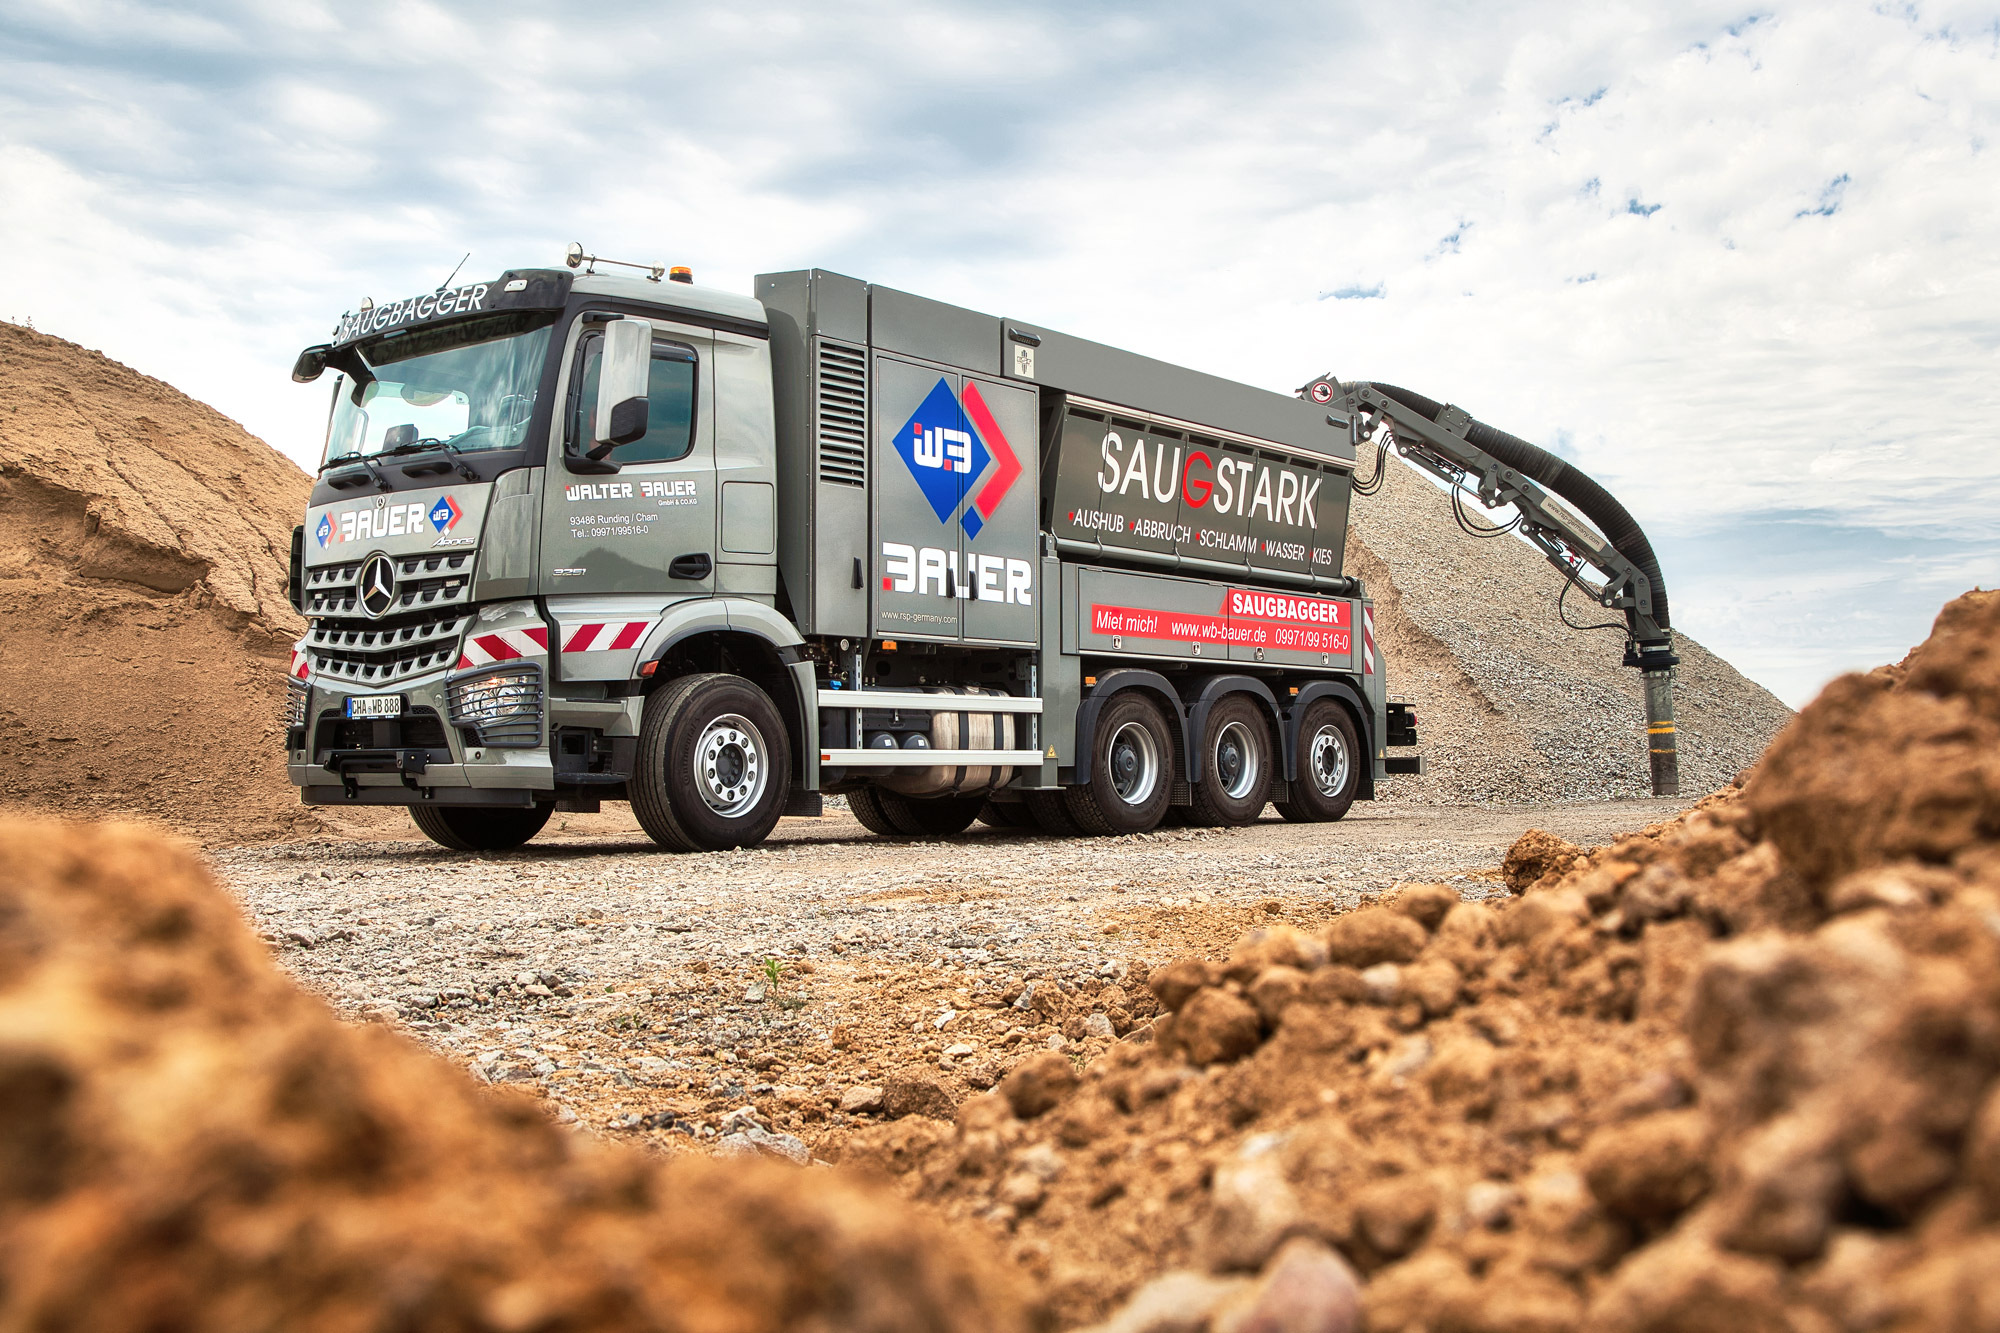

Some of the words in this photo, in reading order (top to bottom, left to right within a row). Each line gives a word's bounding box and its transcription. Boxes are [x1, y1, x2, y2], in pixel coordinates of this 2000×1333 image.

[340, 284, 489, 342] SAUGBAGGER
[565, 482, 634, 501] WALTER
[639, 480, 697, 497] BAUER
[1097, 431, 1323, 529] SAUGSTARK
[339, 502, 426, 542] BAUER
[570, 516, 595, 526] 93486
[597, 514, 630, 524] Runding
[636, 512, 658, 521] Cham
[571, 528, 589, 538] Tel.:
[591, 525, 649, 537] 09971/99516-0
[1073, 508, 1124, 533] AUSHUB
[1133, 518, 1191, 544] ABBRUCH
[1199, 529, 1257, 554] SCHLAMM
[1265, 540, 1305, 561] WASSER
[1312, 547, 1332, 565] KIES
[1547, 502, 1600, 546] www.rsp-germany.com
[882, 541, 1032, 606] BAUER
[881, 611, 958, 624] www.rsp-germany.com
[1232, 592, 1339, 624] SAUGBAGGER
[1096, 610, 1123, 630] Miet
[1125, 615, 1158, 634] mich!
[1171, 621, 1267, 643] www.wb-bauer.de
[1275, 627, 1320, 648] 09971/99
[1321, 632, 1349, 650] 516-0
[352, 700, 366, 714] CHA
[372, 699, 382, 713] WB
[384, 698, 399, 713] 888
